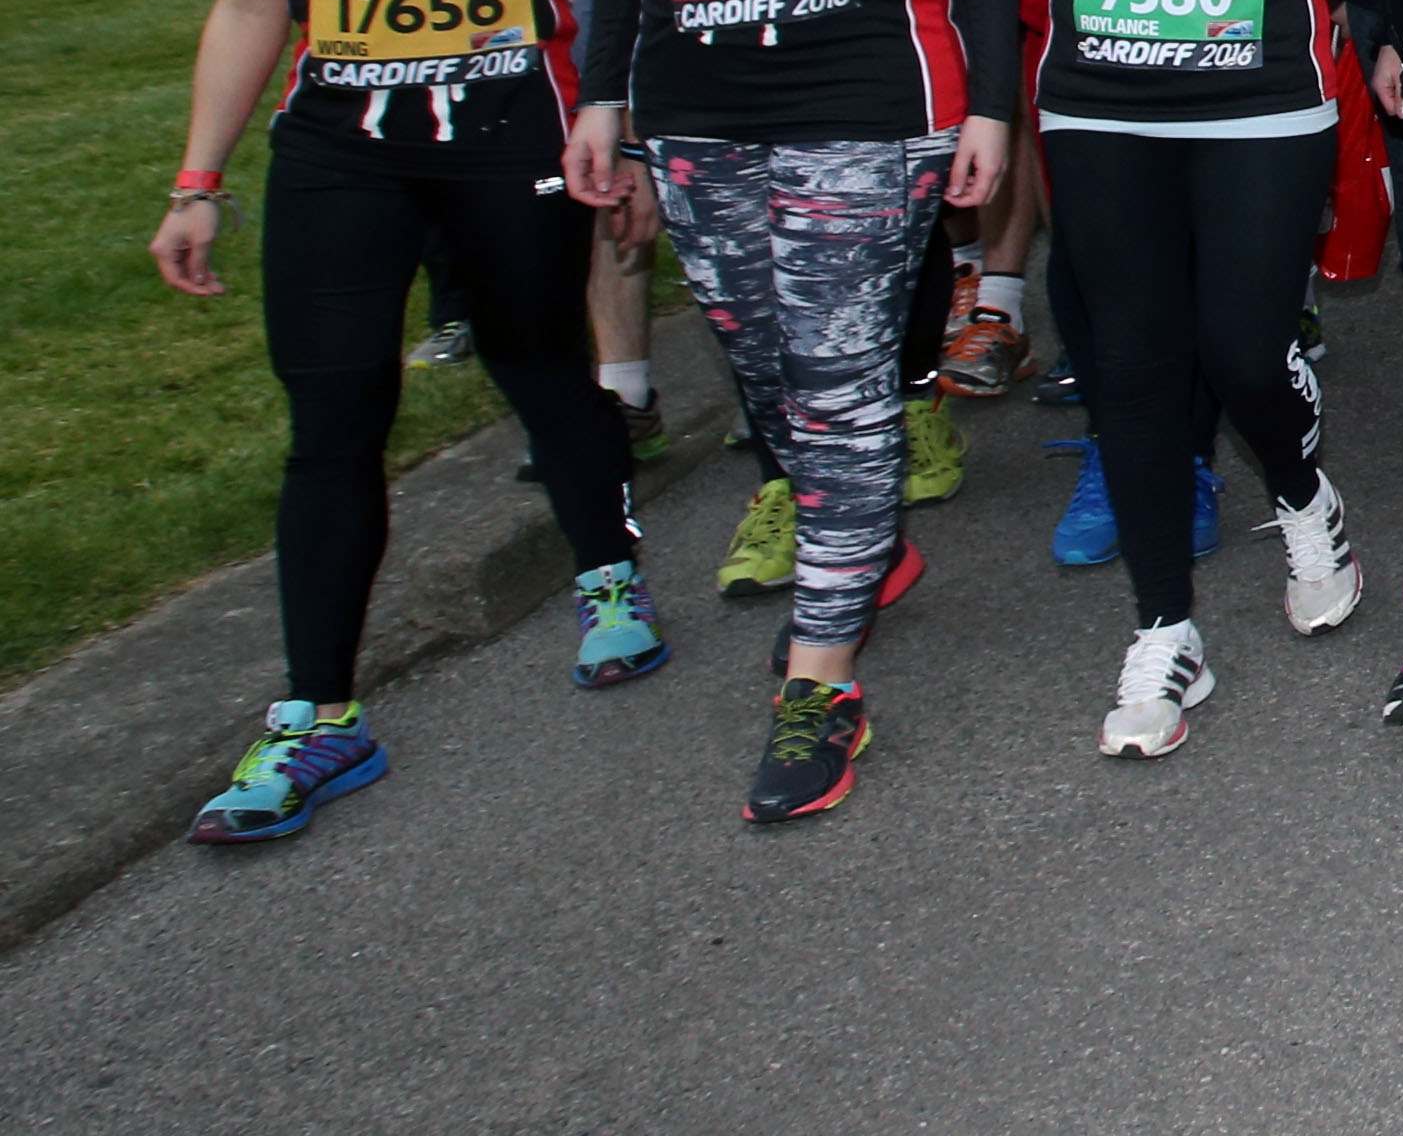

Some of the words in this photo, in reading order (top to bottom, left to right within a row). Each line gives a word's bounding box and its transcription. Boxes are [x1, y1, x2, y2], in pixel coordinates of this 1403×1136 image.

[1079, 14, 1160, 36] ROYLANCE
[317, 39, 370, 57] WONG
[1082, 36, 1197, 67] CARDIFF
[1197, 42, 1256, 67] 2016
[321, 58, 462, 87] CARDIFF
[464, 48, 529, 81] 2016
